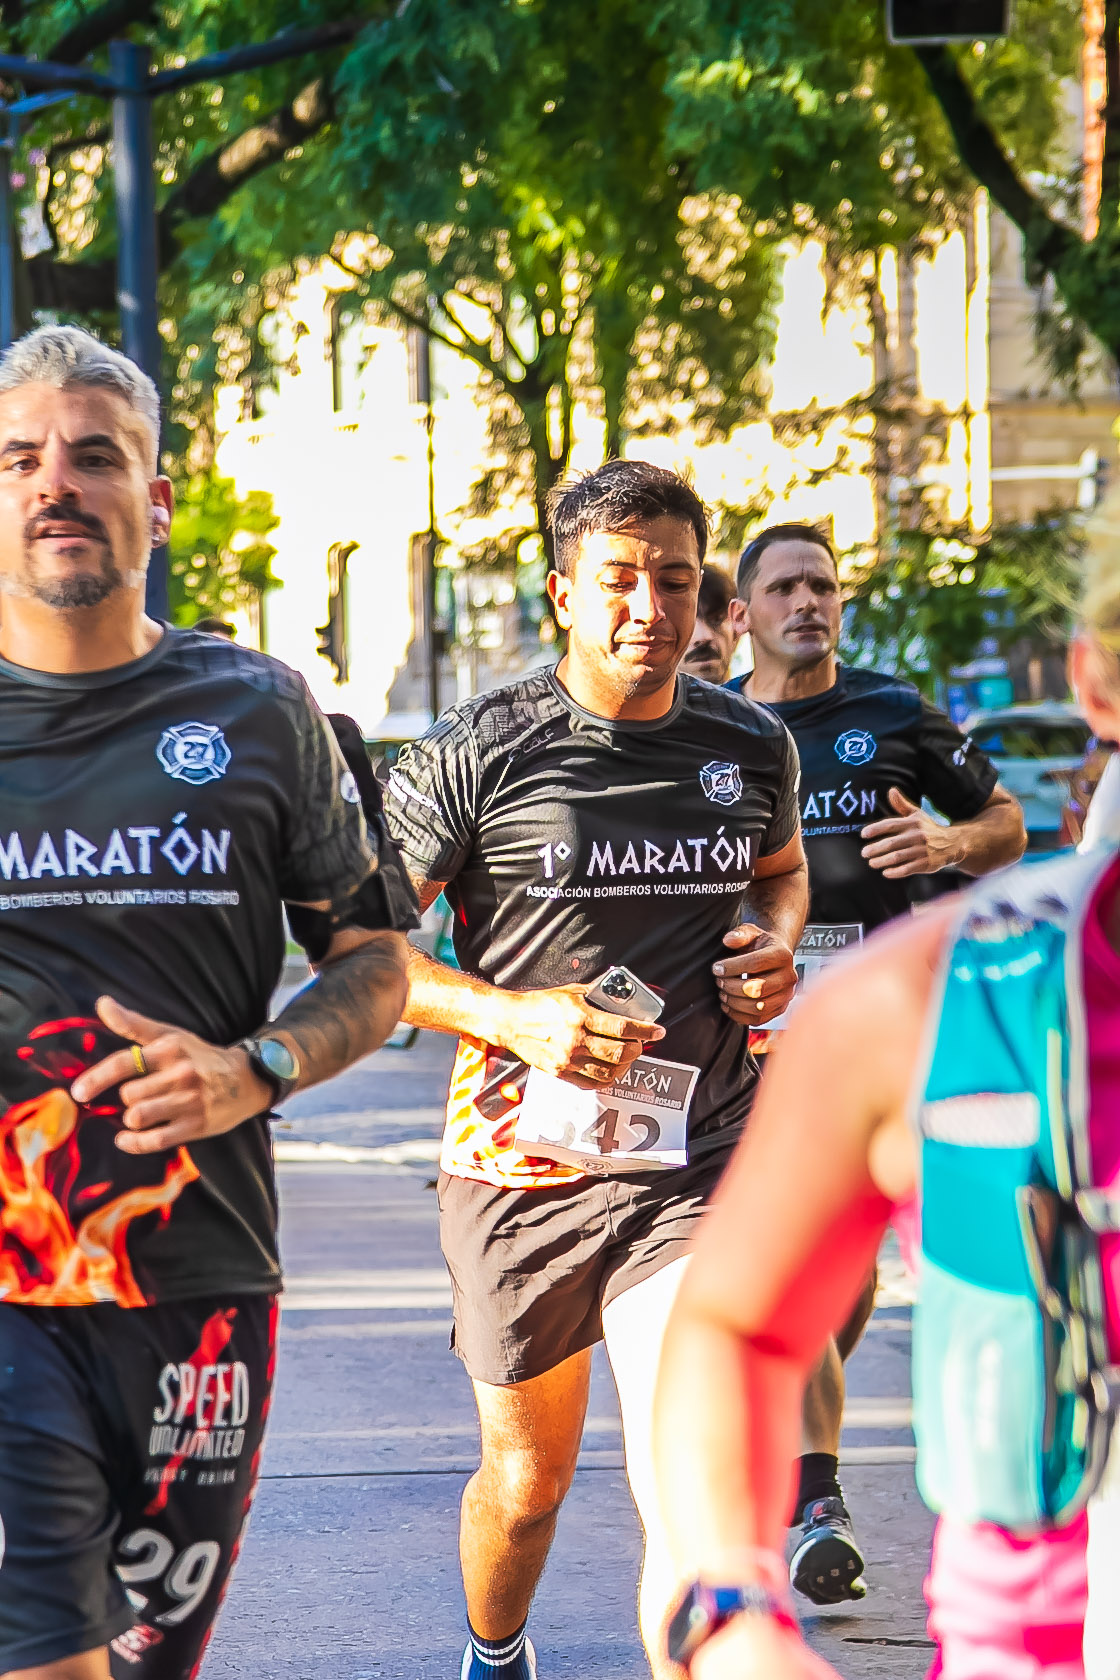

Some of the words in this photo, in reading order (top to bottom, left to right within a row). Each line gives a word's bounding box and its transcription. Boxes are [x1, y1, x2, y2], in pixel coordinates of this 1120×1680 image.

[184, 741, 209, 760] 27
[802, 781, 876, 819] ATÓN
[801, 824, 850, 837] OLUNTARIOS
[586, 826, 750, 877] MARATÓN
[84, 888, 187, 905] VOLUNTARIOS
[526, 885, 590, 900] ASOCIACIÓN
[594, 884, 650, 898] BOMBEROS
[653, 883, 724, 896] VOLUNTARIOS
[801, 930, 846, 947] ATÓN
[614, 1068, 672, 1094] ATÓN
[153, 1361, 250, 1428] SPEED
